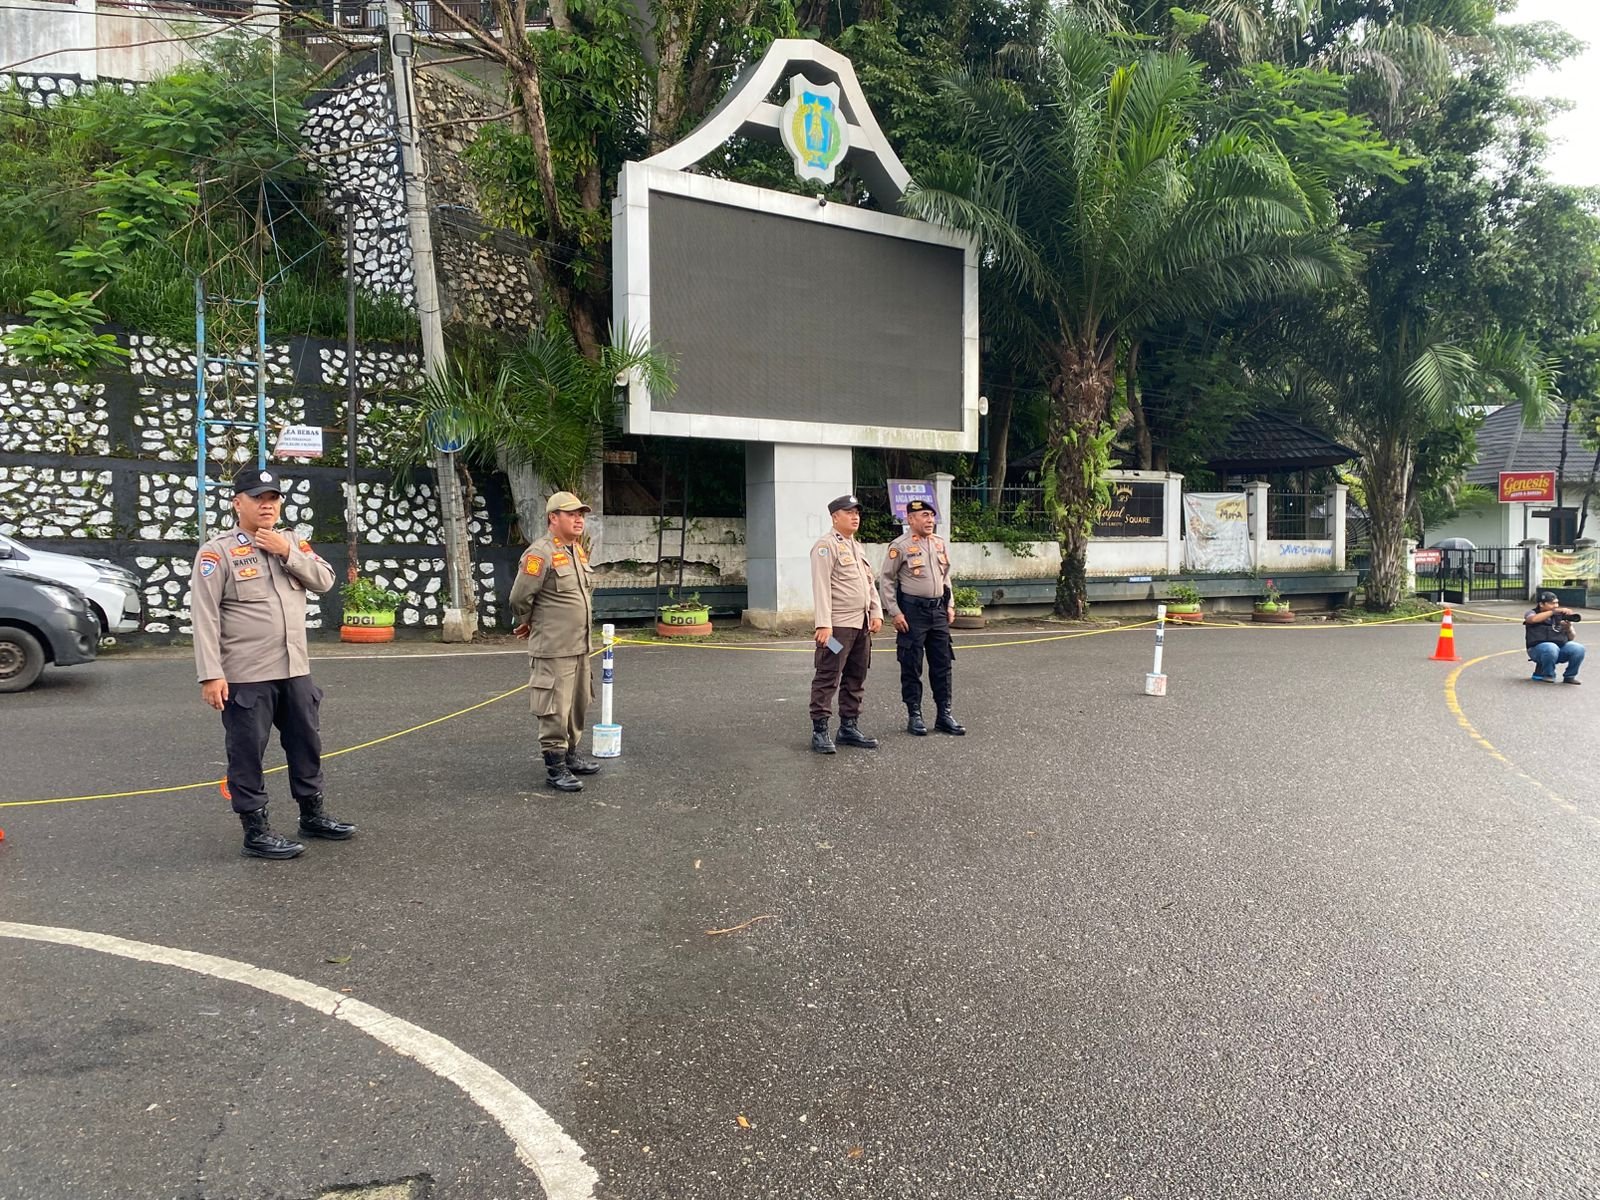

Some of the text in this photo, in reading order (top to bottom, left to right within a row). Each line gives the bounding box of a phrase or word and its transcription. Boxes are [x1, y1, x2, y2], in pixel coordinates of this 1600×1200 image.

[1504, 474, 1550, 496] Genesis
[1095, 504, 1151, 524] Royal SQUARE
[232, 556, 258, 567] WAHYU
[346, 615, 376, 625] PDGI
[670, 615, 697, 625] PDGI
